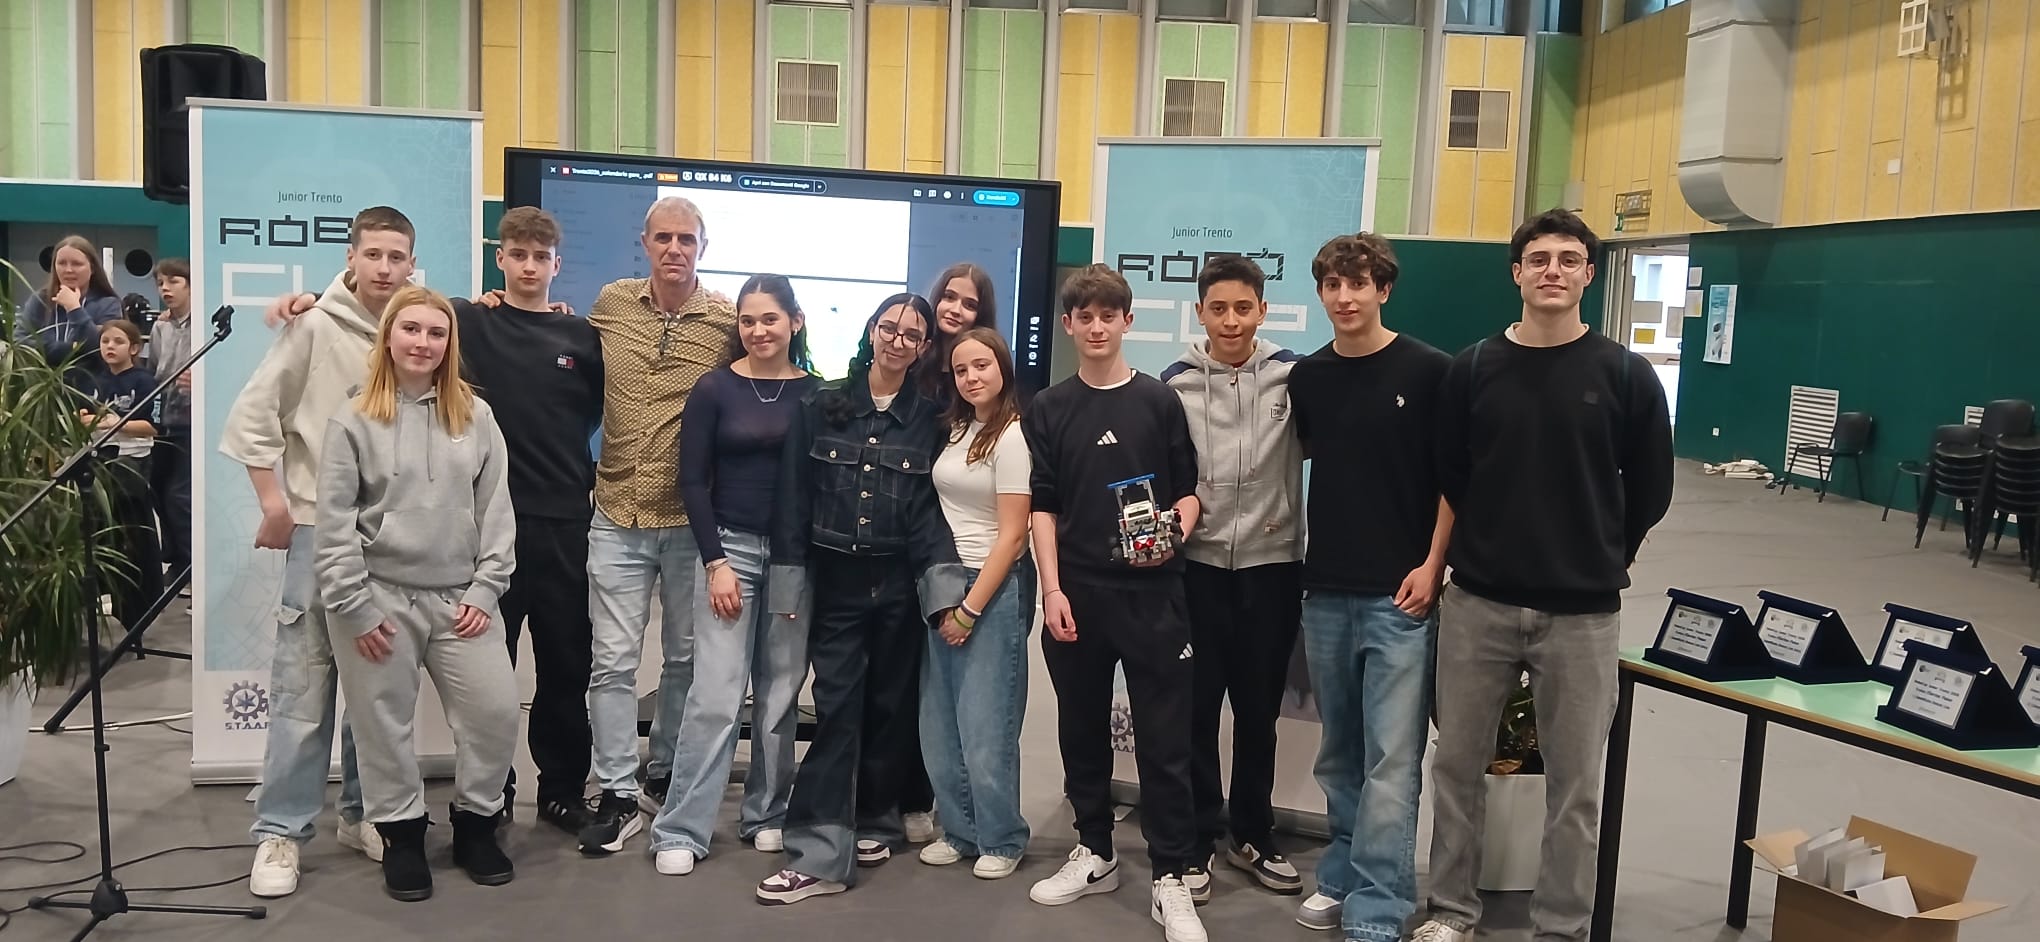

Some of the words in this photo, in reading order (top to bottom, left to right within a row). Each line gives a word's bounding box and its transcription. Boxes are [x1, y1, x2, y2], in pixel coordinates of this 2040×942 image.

[278, 191, 308, 203] Junior
[311, 192, 343, 203] Trento
[219, 214, 354, 248] ROB
[1171, 226, 1201, 239] Junior
[1202, 227, 1233, 239] Trento
